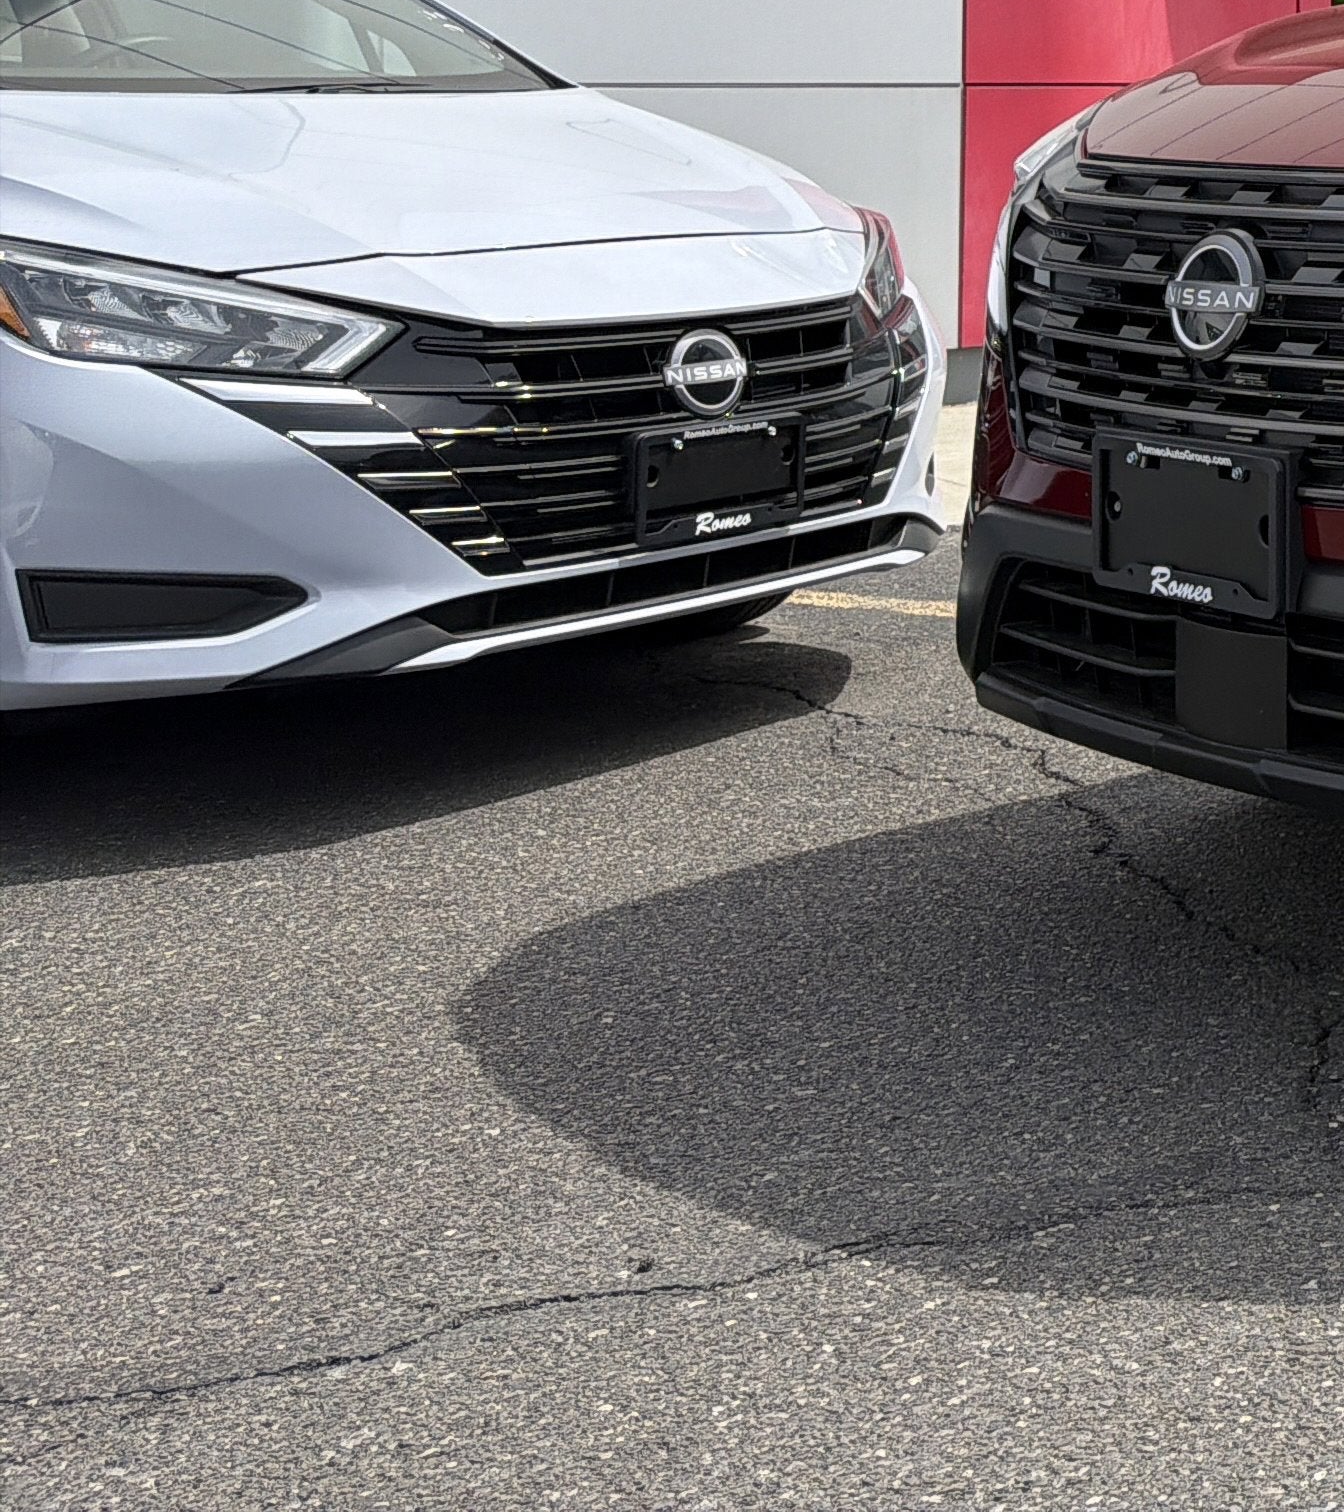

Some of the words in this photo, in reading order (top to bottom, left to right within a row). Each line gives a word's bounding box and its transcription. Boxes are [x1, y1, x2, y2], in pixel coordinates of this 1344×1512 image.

[1168, 285, 1255, 309] NISSAN
[665, 361, 747, 385] NISSAN
[1136, 442, 1232, 467] RomeoAutoGroup.com
[695, 511, 751, 536] Romeo
[1150, 565, 1213, 603] Romeo
